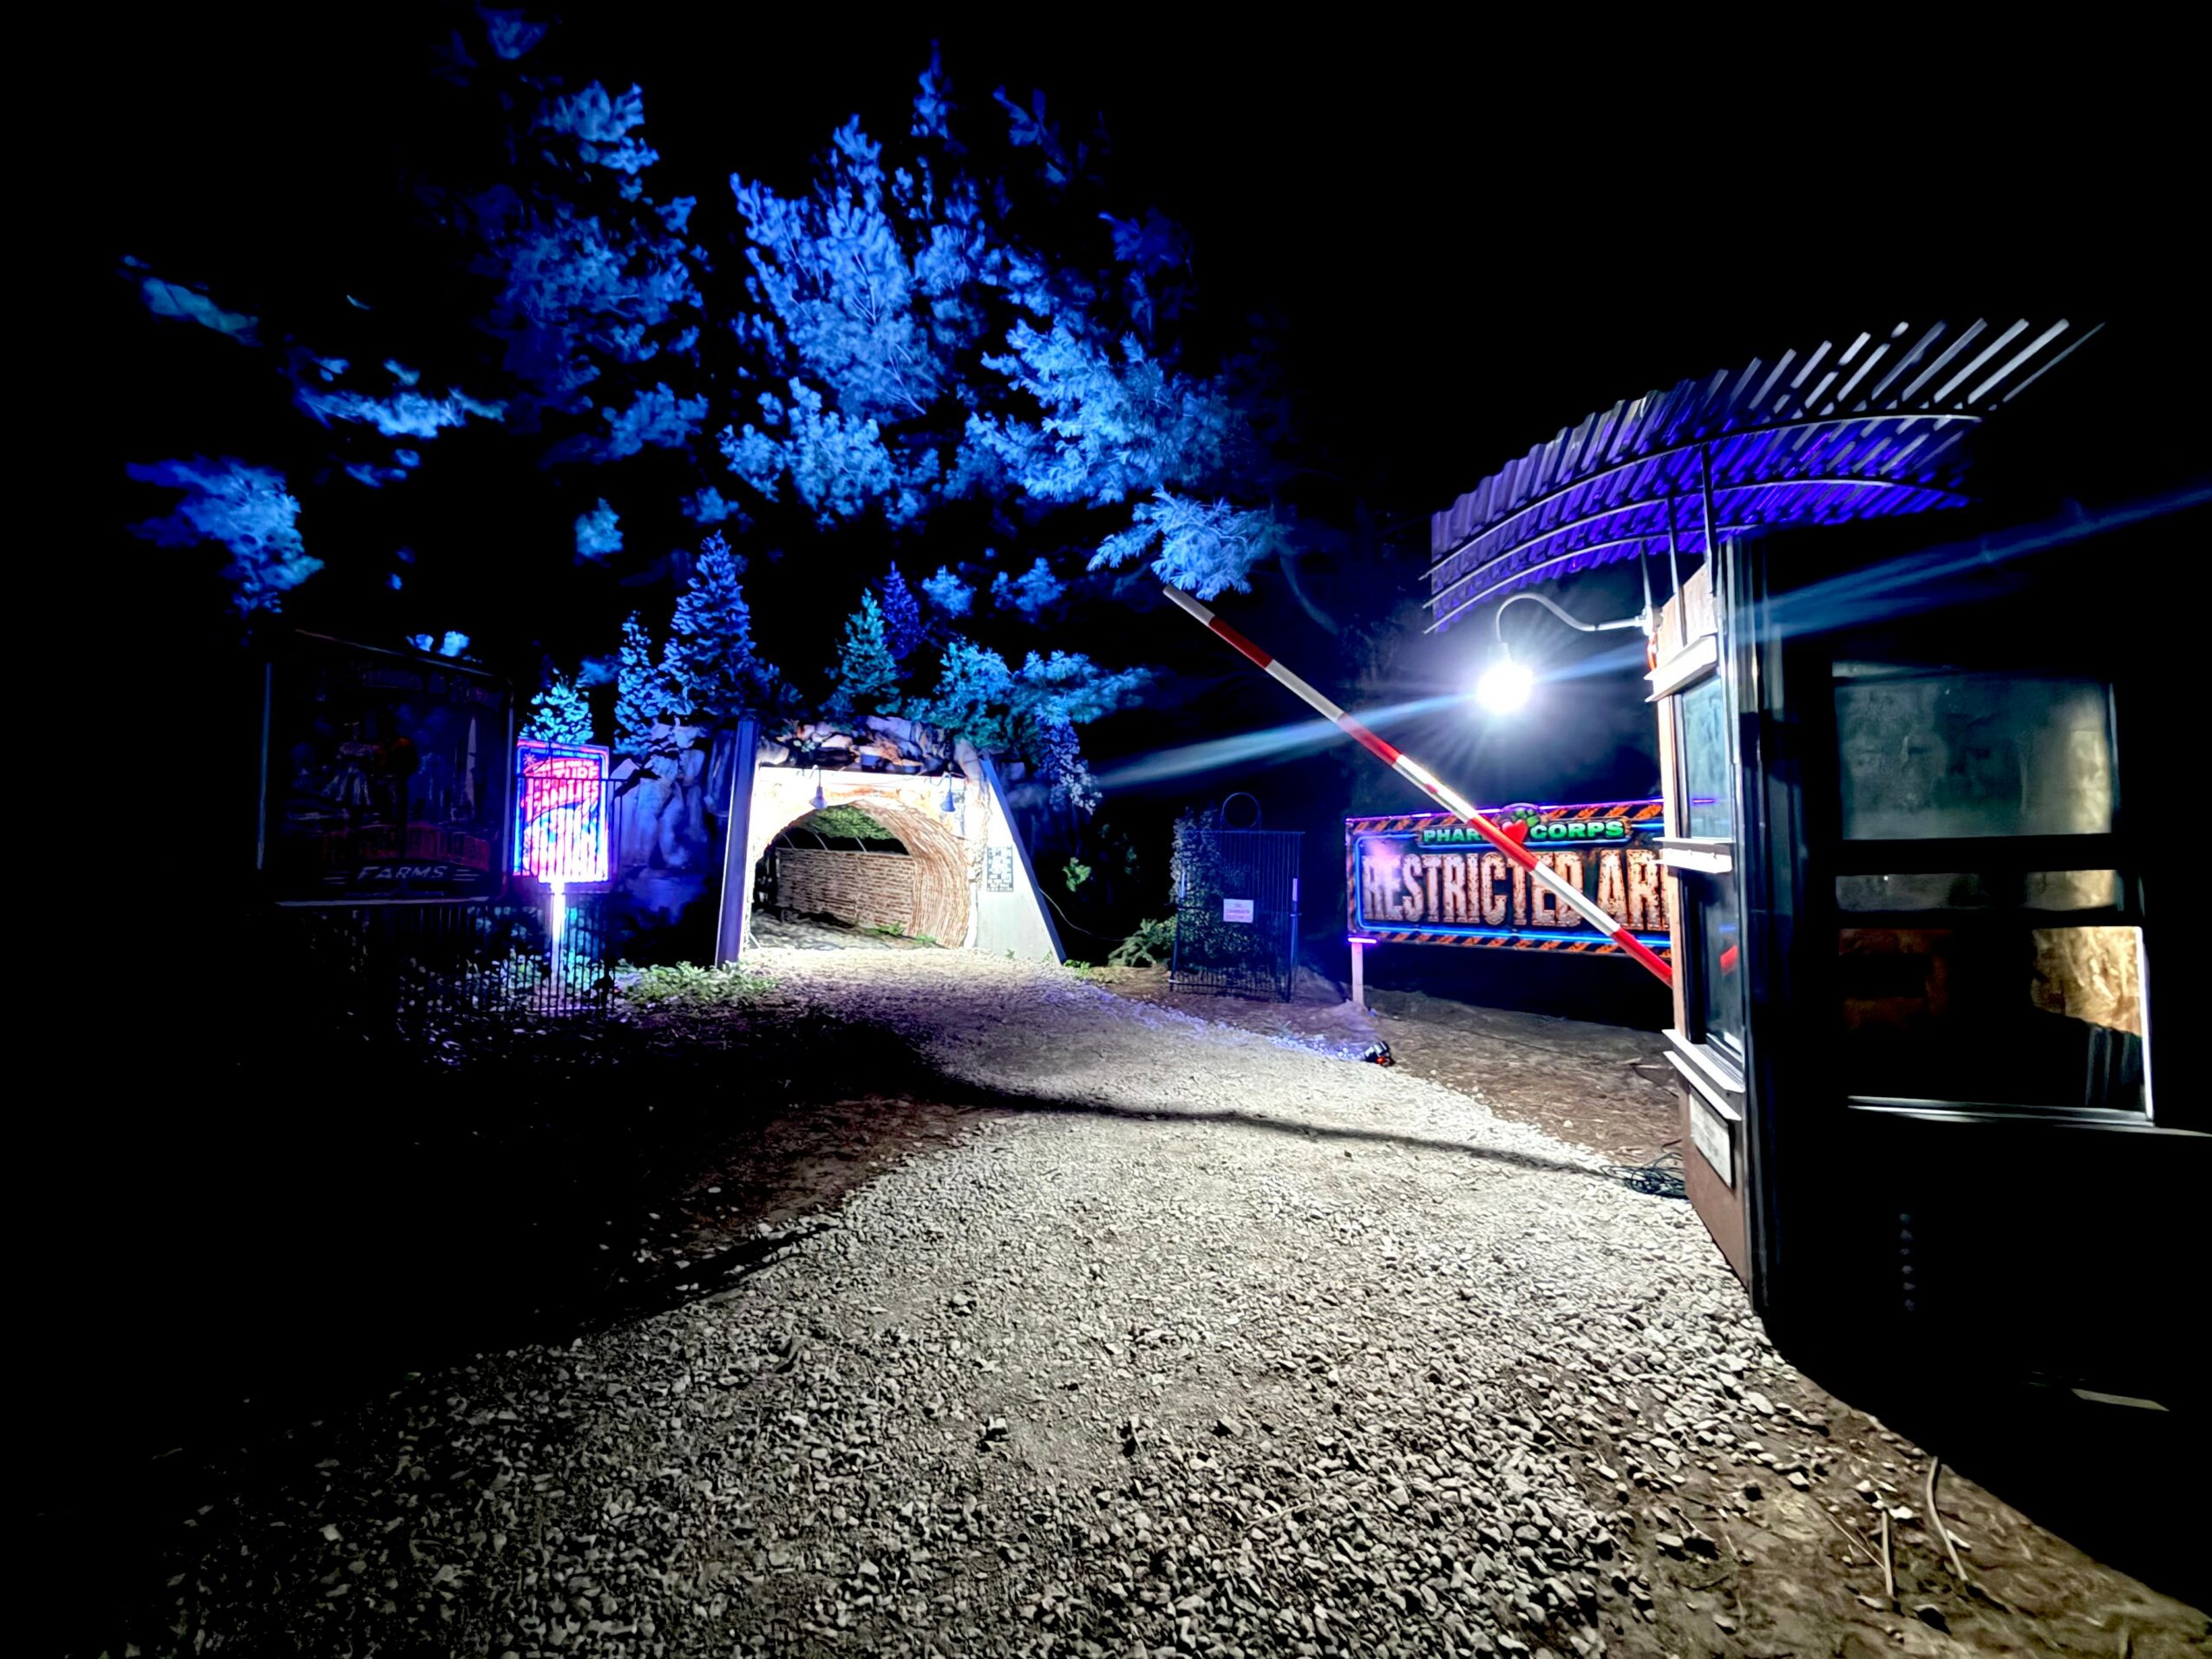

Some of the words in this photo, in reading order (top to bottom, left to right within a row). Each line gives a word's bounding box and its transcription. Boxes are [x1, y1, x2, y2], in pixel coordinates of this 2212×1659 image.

[1530, 820, 1624, 839] CORPS
[357, 865, 448, 879] FARMS
[1362, 852, 1584, 926] RESTRICTED
